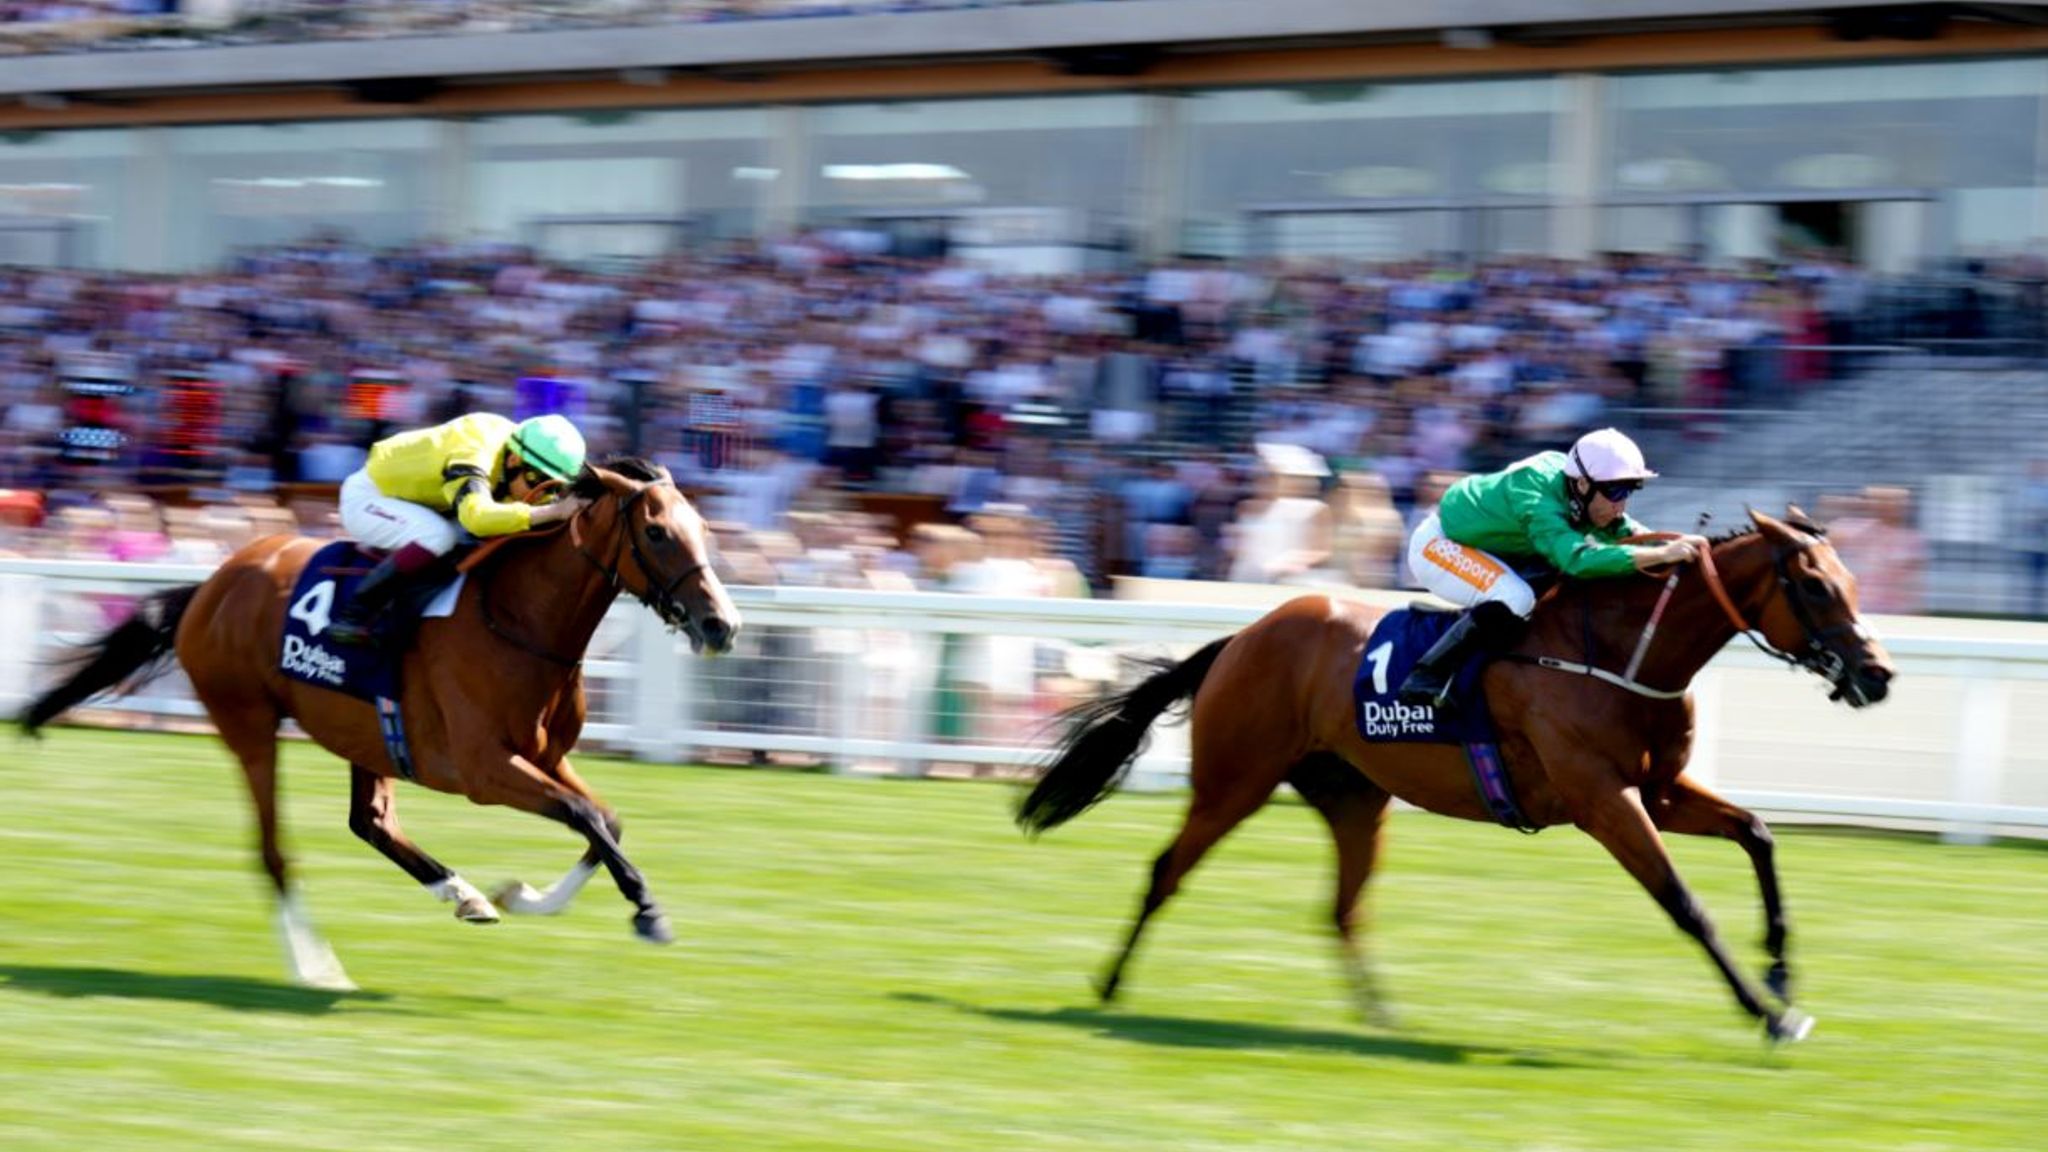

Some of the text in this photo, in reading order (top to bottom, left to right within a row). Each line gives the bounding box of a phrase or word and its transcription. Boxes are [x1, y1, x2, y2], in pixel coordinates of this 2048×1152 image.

[289, 580, 336, 636] 4
[1367, 640, 1393, 694] 1
[1363, 700, 1433, 721] Dubai
[1366, 721, 1434, 737] Duty Free
